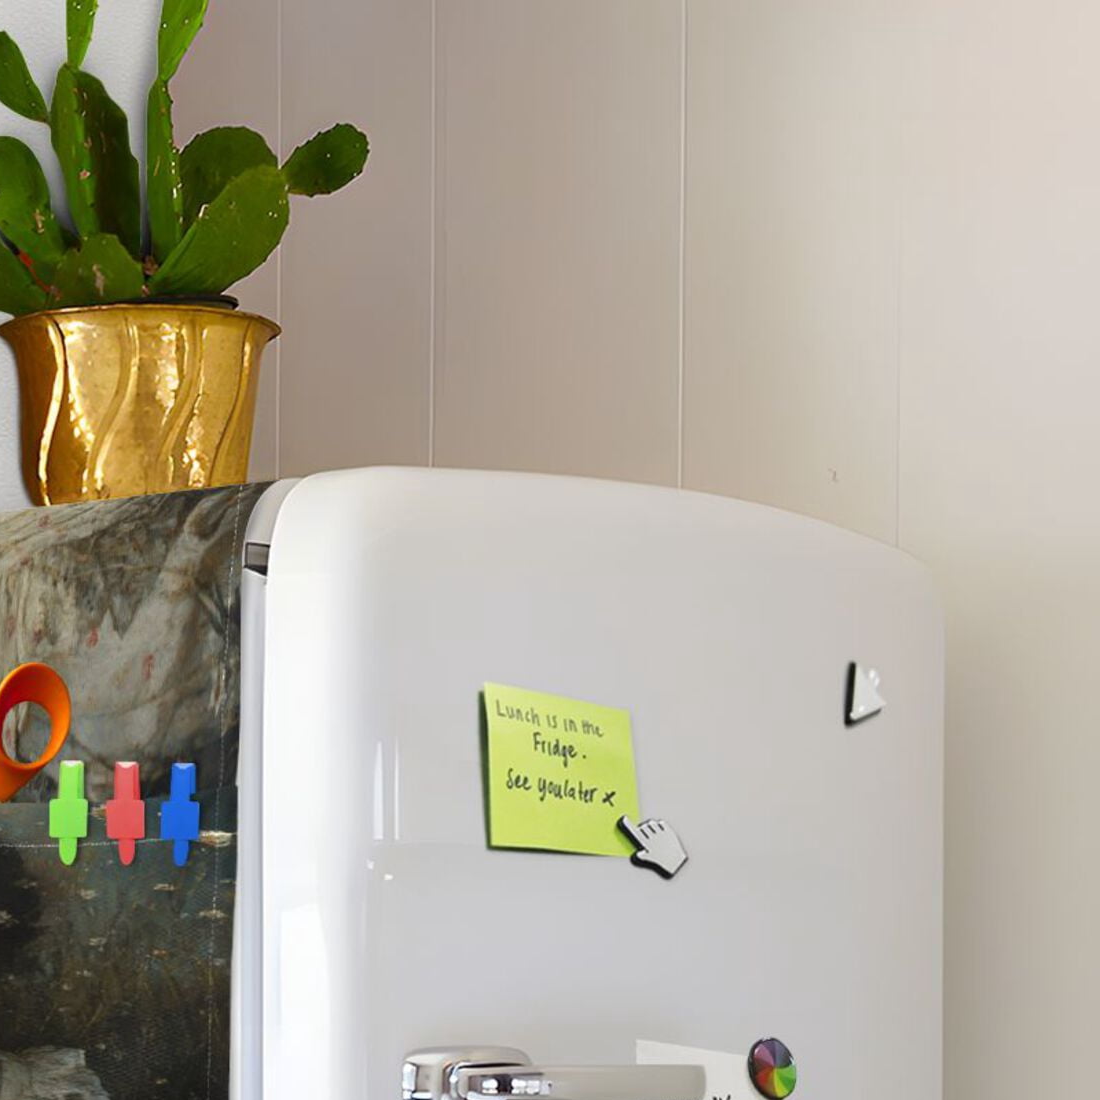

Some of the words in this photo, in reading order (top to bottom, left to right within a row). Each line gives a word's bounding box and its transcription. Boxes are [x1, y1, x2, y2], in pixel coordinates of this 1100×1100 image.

[496, 699, 541, 727] Lunch
[546, 714, 558, 729] is
[563, 718, 578, 733] in
[582, 720, 604, 738] the
[506, 768, 532, 791] See
